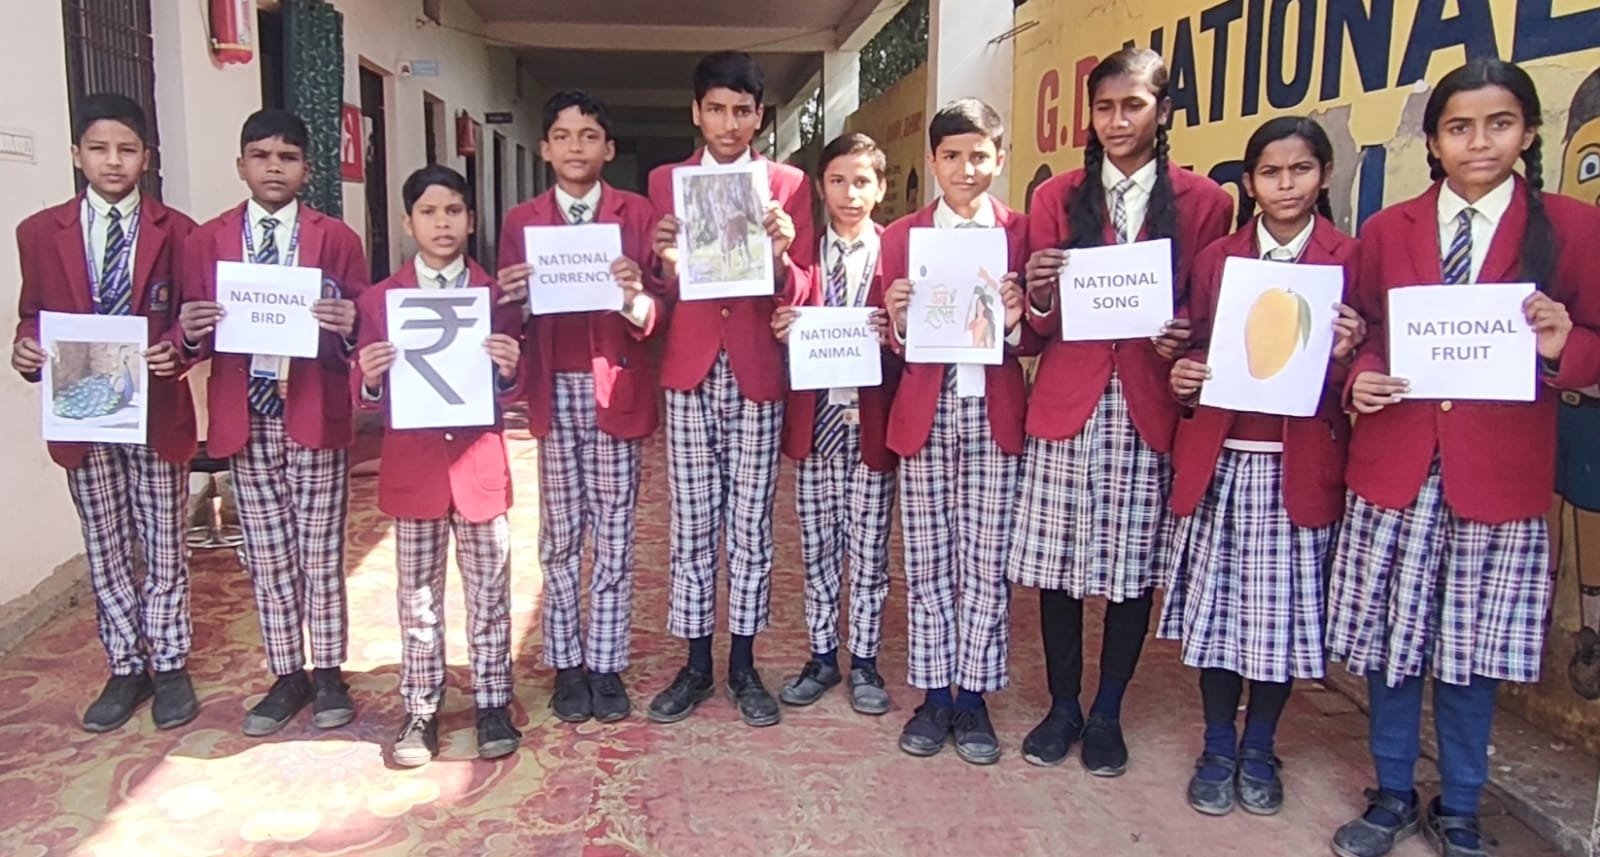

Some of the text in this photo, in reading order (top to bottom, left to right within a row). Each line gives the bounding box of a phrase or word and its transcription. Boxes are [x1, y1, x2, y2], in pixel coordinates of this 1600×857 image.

[1121, 0, 1600, 131] ATIONAL
[538, 252, 609, 266] NATIONAL
[540, 271, 611, 284] CURRENCY
[1073, 272, 1158, 289] NATIONAL
[230, 290, 307, 306] NATIONAL
[1092, 295, 1139, 310] SONG
[251, 311, 286, 325] BIRD
[800, 326, 868, 341] NATIONAL
[1407, 319, 1517, 336] NATIONAL
[808, 346, 862, 360] ANIMAL
[1431, 345, 1492, 360] FRUIT
